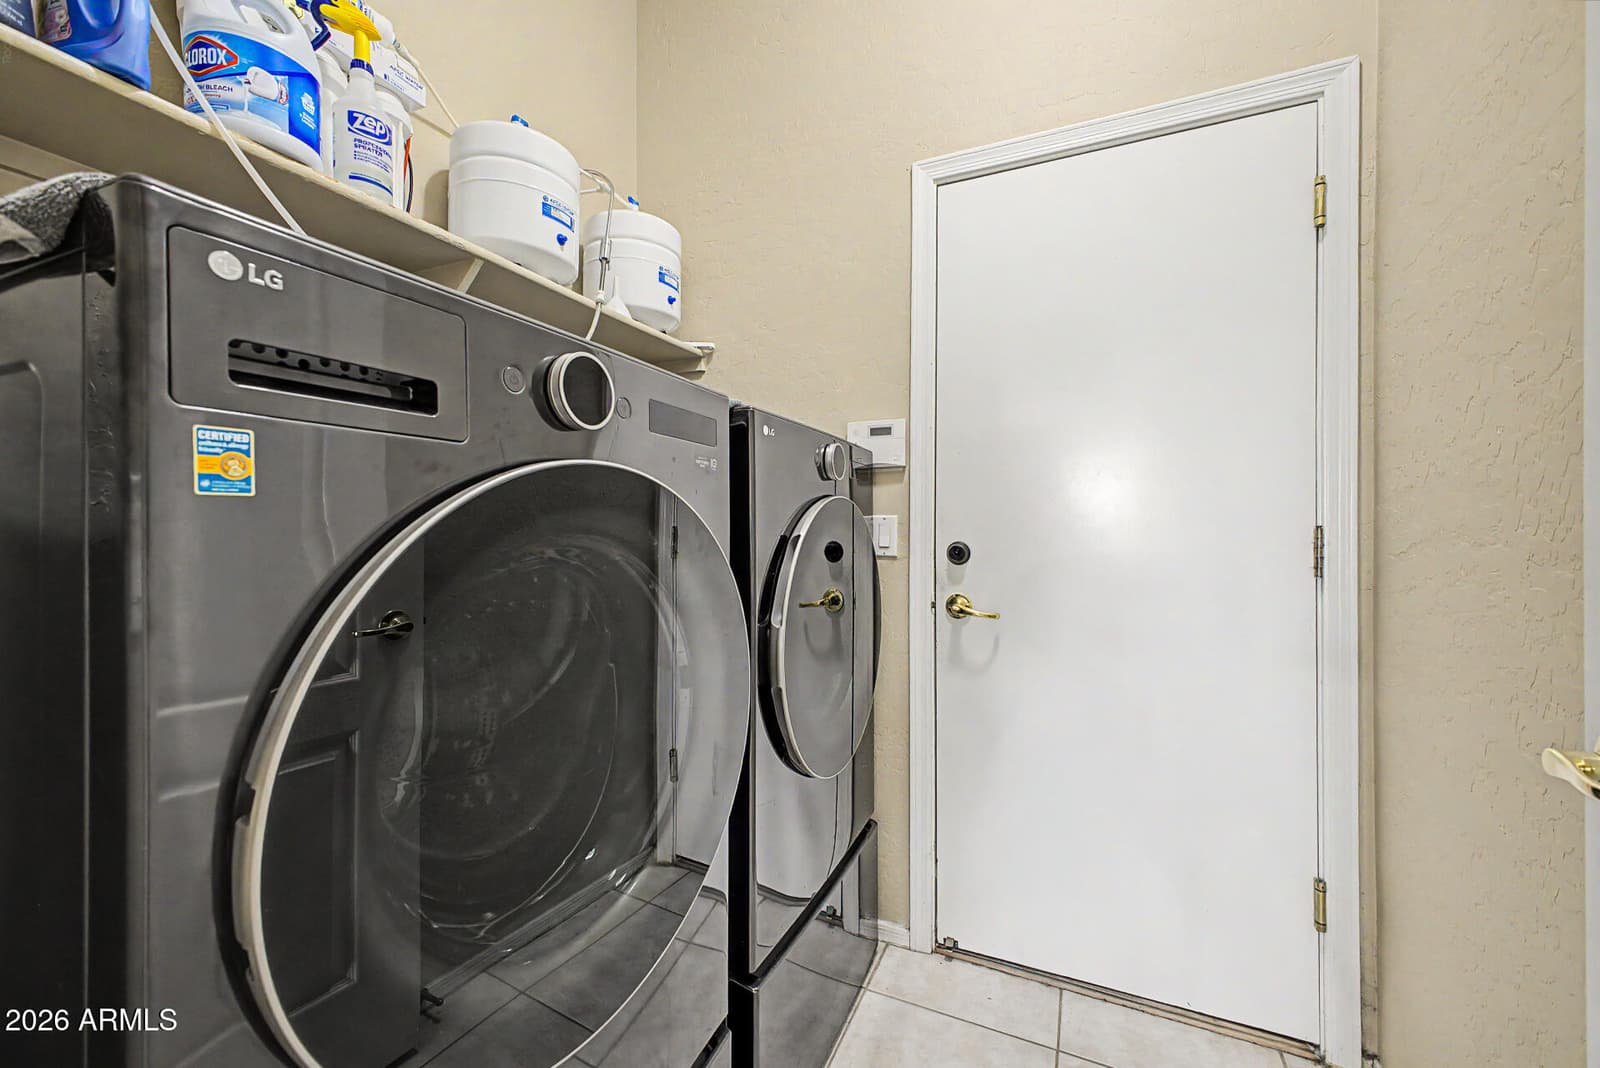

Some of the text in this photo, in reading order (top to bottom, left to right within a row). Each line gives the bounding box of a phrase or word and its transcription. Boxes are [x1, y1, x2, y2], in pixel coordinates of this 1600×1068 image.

[206, 84, 233, 92] BLEACH
[247, 262, 284, 290] LG
[197, 430, 250, 443] CERTIFIED
